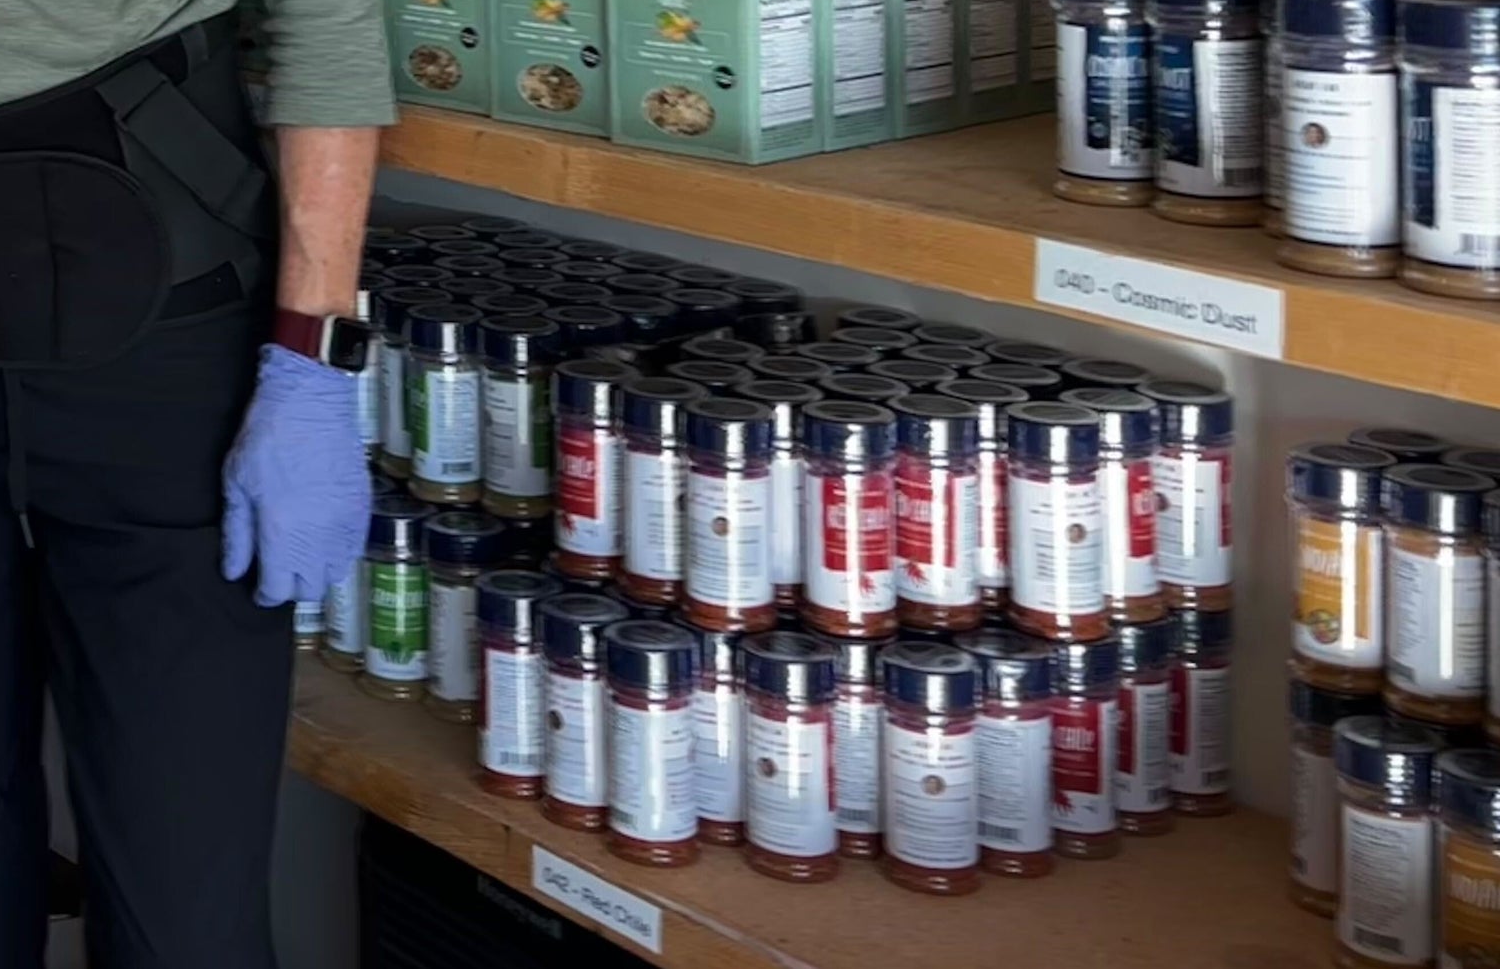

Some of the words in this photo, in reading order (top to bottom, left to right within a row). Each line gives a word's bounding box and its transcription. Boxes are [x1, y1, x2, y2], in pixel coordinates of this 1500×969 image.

[1054, 268, 1095, 295] 040
[1112, 282, 1198, 321] Cosmic
[1200, 302, 1258, 335] Dust
